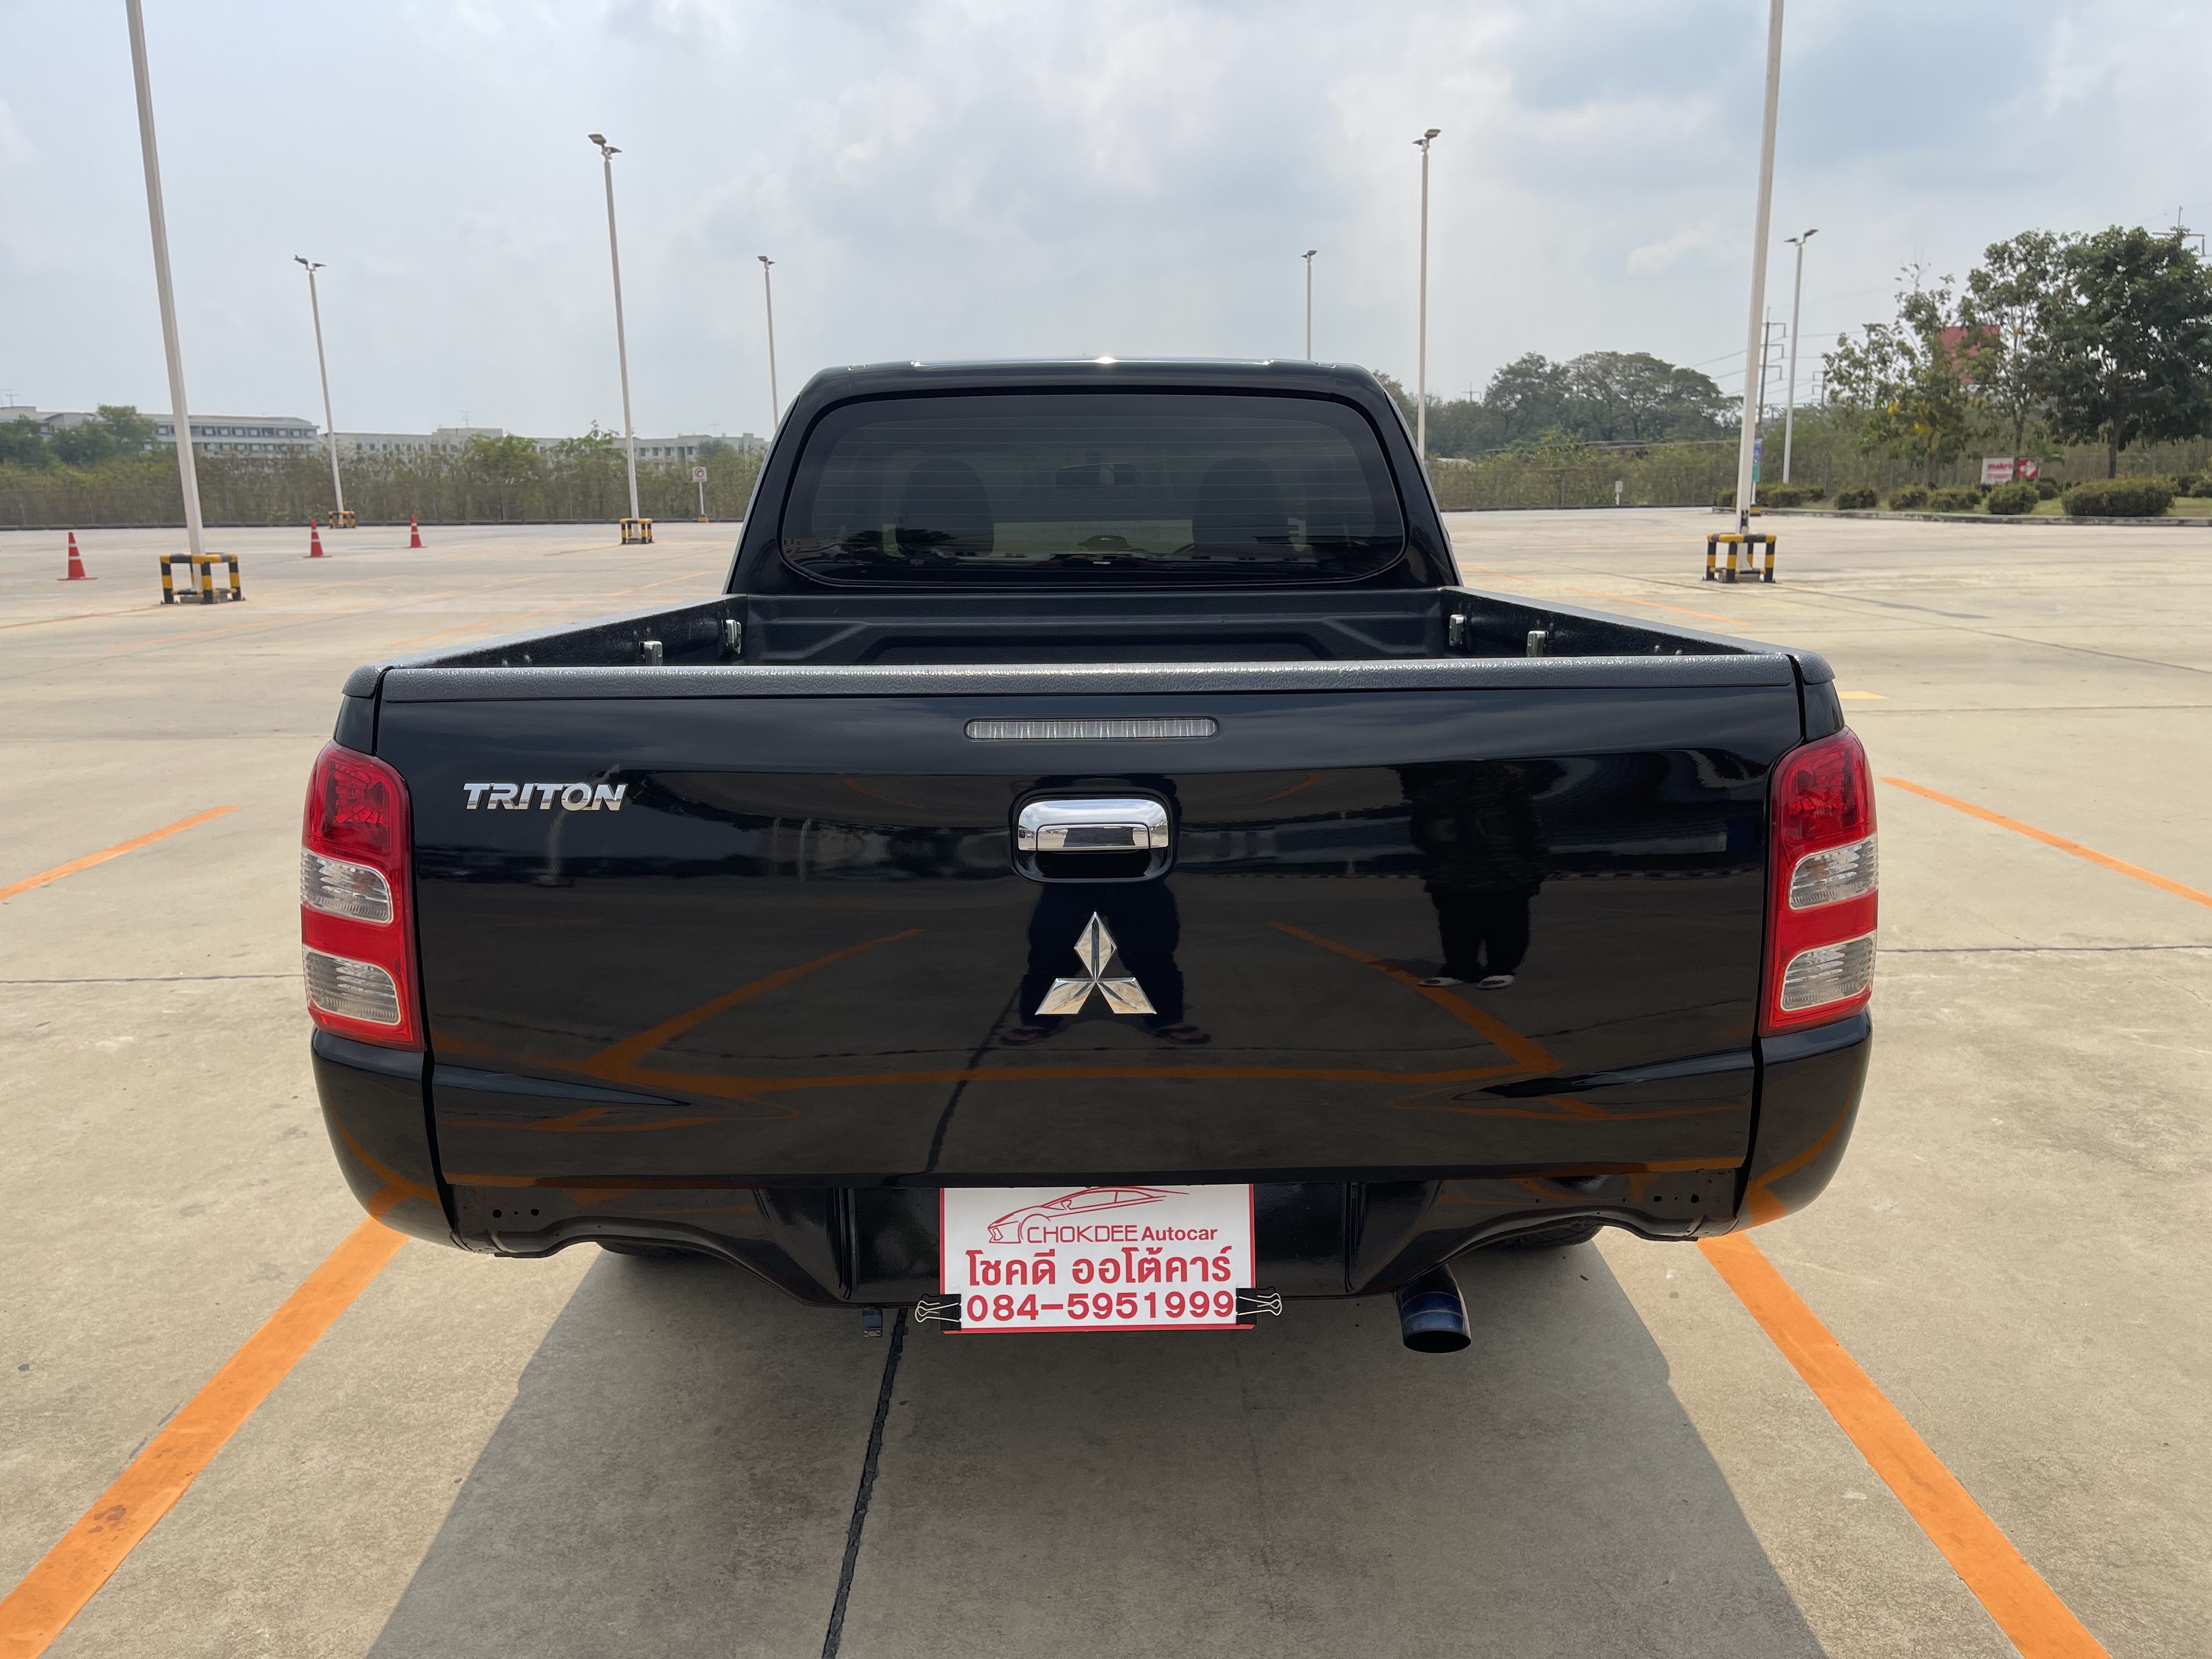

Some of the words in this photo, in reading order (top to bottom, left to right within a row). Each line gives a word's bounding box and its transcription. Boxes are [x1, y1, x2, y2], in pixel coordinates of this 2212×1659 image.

[464, 782, 628, 811] TRITON
[1028, 1225, 1138, 1243] CHOKDEE
[1141, 1226, 1217, 1241] Autocar
[966, 1249, 1055, 1286] โชคดี
[1072, 1245, 1232, 1284] ออโต้คาร์
[967, 1290, 1234, 1322] 084-5951999
